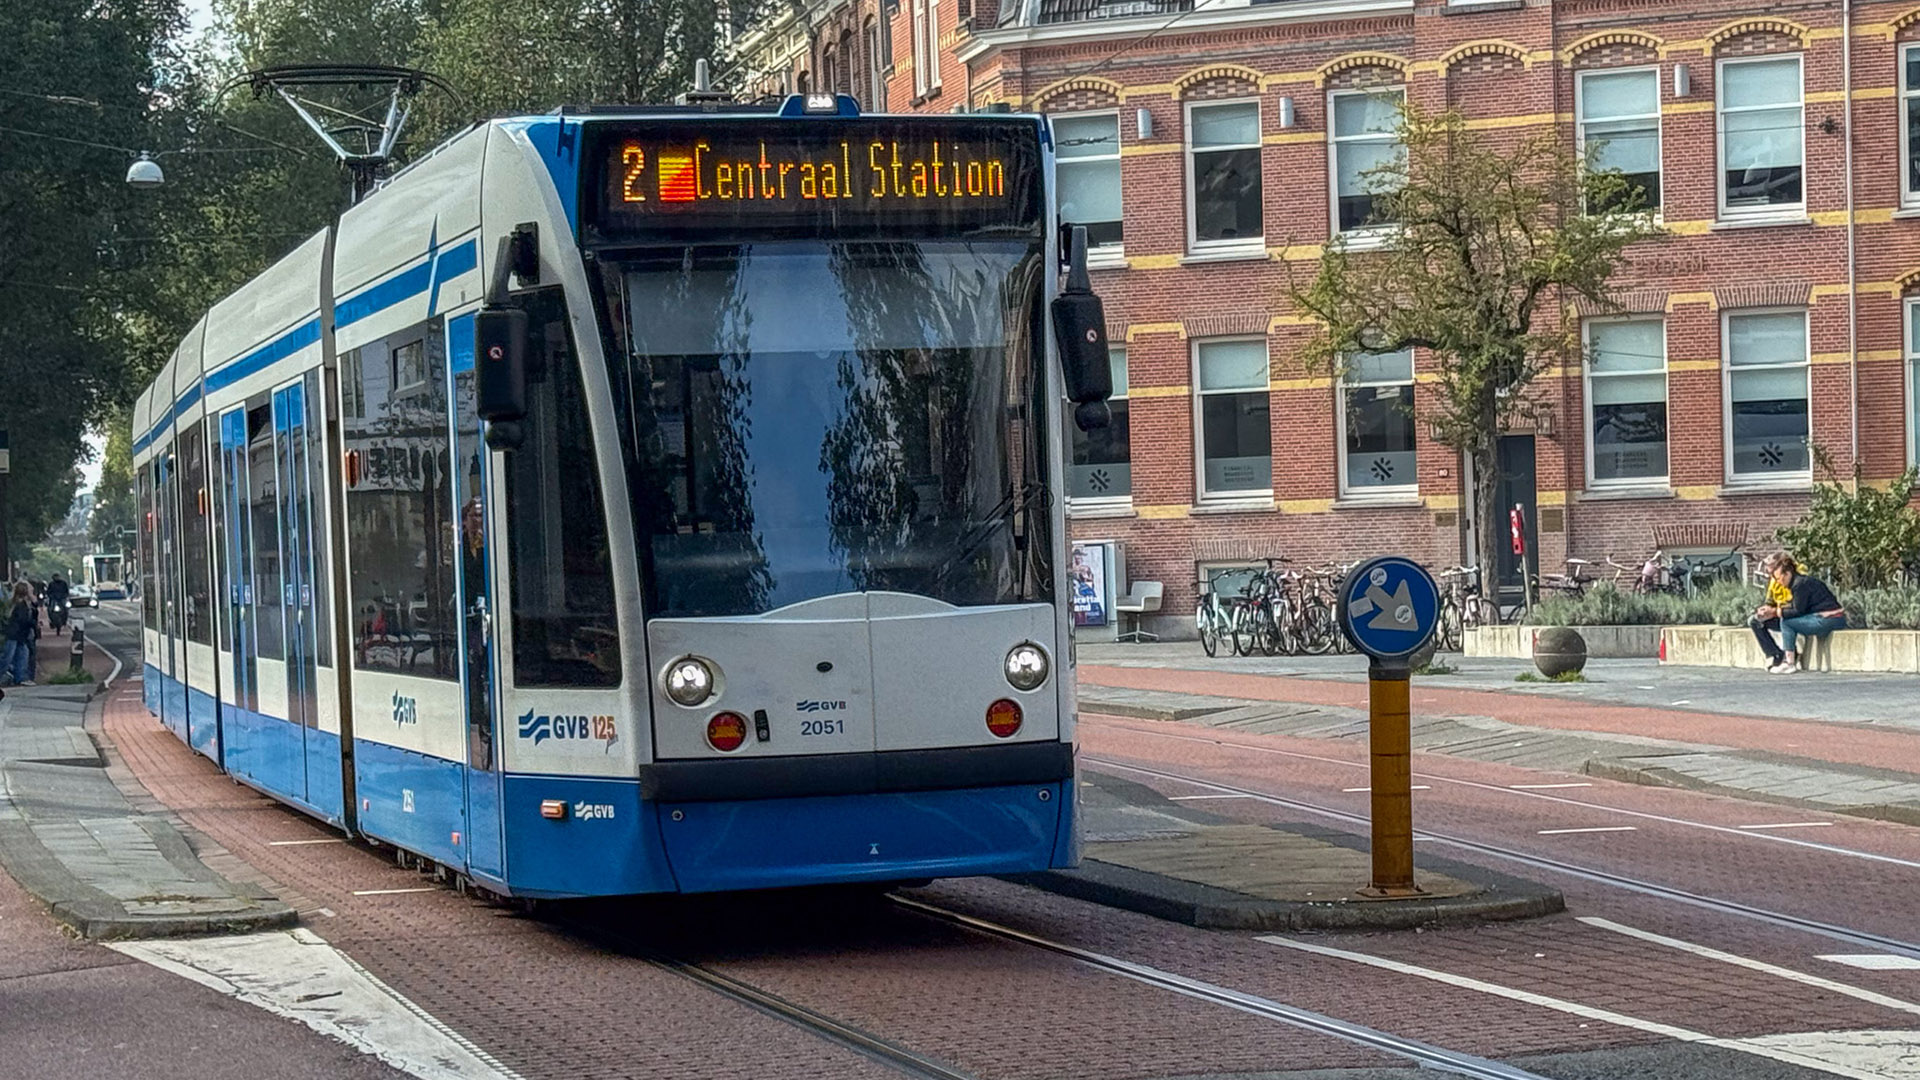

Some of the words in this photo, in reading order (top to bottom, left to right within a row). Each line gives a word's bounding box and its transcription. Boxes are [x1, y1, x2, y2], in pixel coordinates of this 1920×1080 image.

[623, 145, 646, 202] 2
[695, 140, 853, 200] Centraal
[869, 140, 1004, 199] Station
[821, 700, 846, 711] GVB
[553, 715, 589, 739] GVB
[592, 715, 615, 740] 125
[801, 719, 845, 736] 2051
[593, 804, 615, 819] GVB
